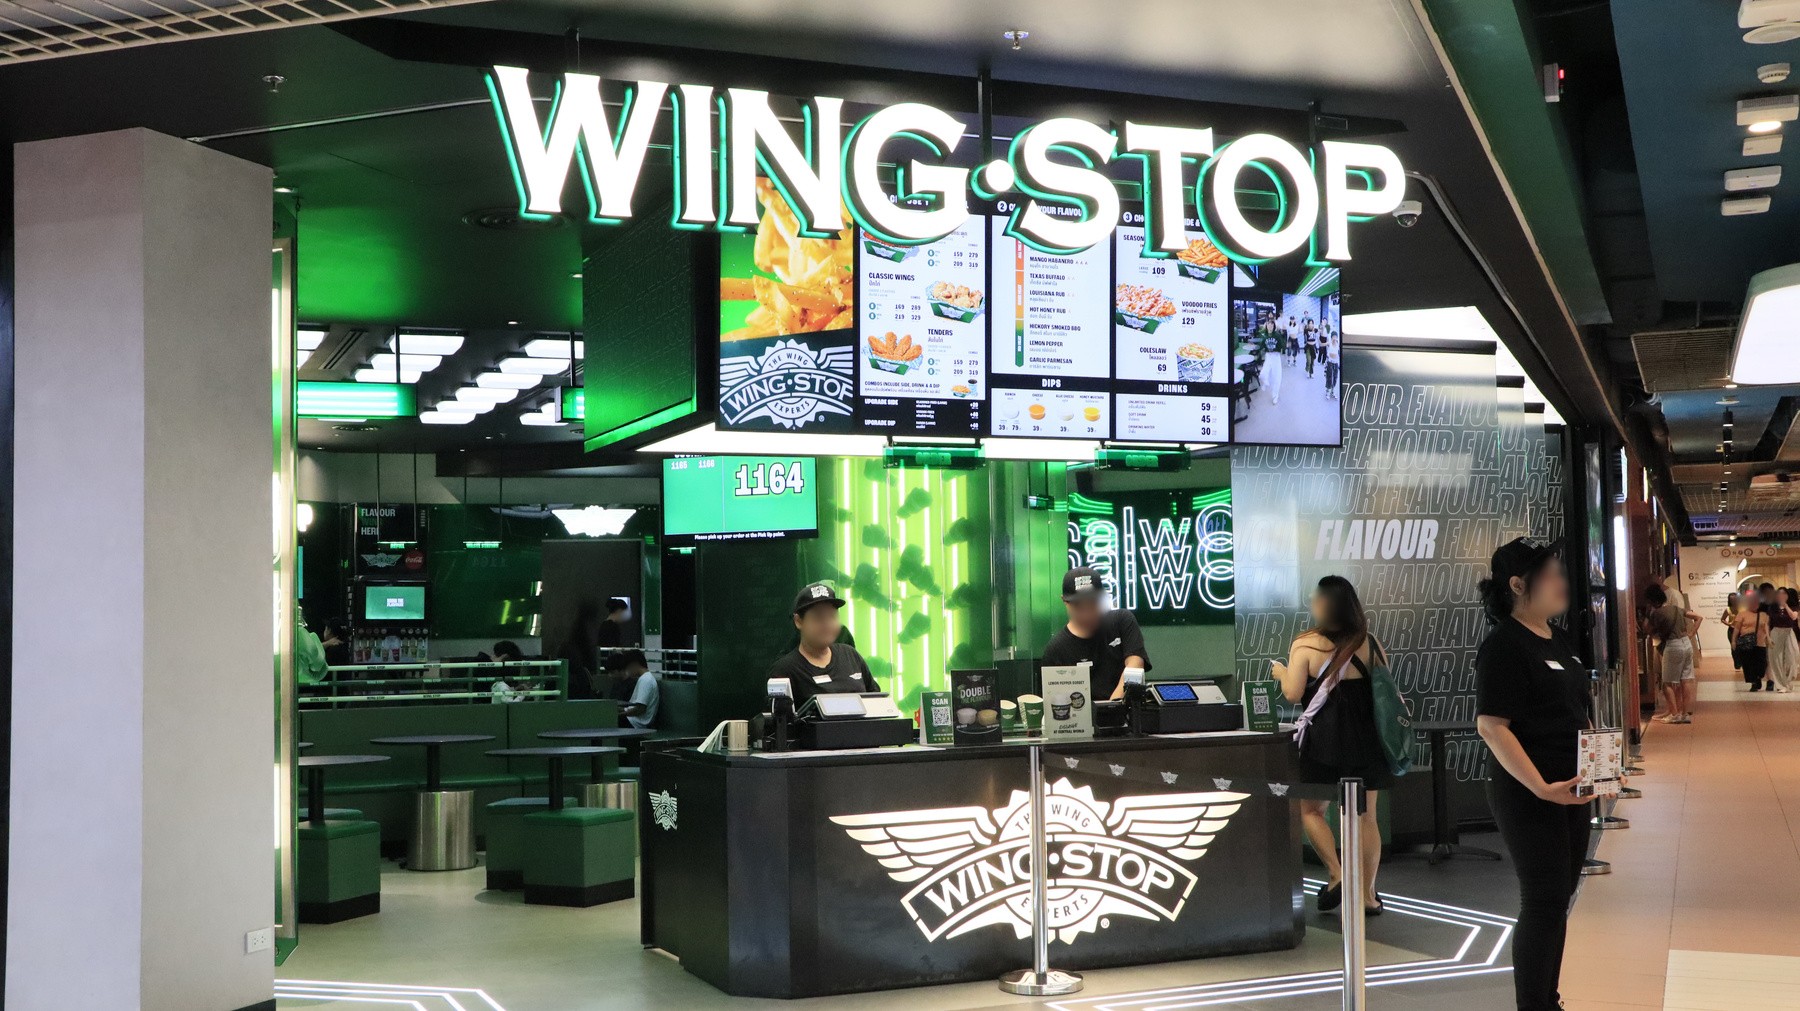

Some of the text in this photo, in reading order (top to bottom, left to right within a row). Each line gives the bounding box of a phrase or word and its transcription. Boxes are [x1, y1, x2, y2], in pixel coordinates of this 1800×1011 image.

[769, 352, 809, 368] THE WING
[1042, 379, 1061, 387] DIPS
[1158, 384, 1188, 393] DRINKS
[774, 401, 810, 414] EXPERTS
[1201, 403, 1211, 411] 59
[1201, 415, 1211, 423] 45
[1201, 427, 1211, 435] 30
[735, 462, 804, 496] 1164
[361, 508, 395, 517] FLAVOUR
[1313, 518, 1439, 560] FLAVOUR
[1688, 572, 1694, 581] 6
[960, 686, 991, 699] DOUBLE
[1052, 803, 1091, 829] WING
